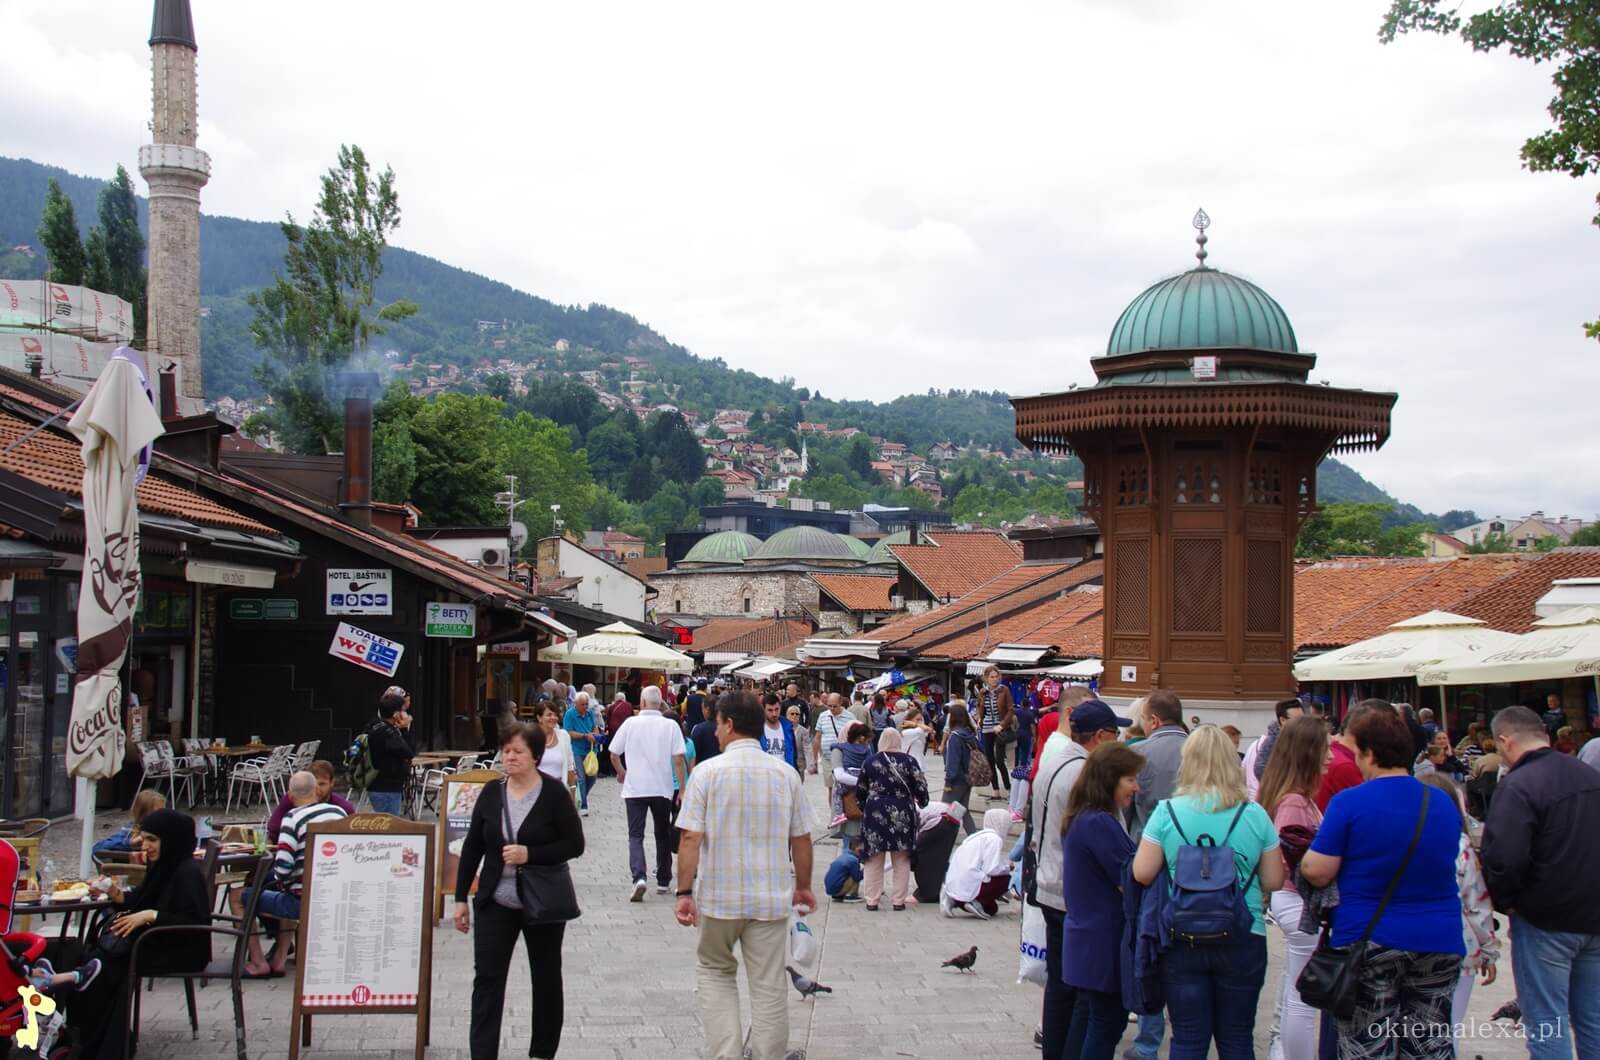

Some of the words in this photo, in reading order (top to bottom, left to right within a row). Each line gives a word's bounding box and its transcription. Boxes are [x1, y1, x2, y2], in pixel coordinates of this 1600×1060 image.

[329, 571, 351, 579] HOTEL
[356, 570, 387, 579] BAŠTINA
[338, 636, 366, 654] WC
[350, 627, 393, 647] TOALET
